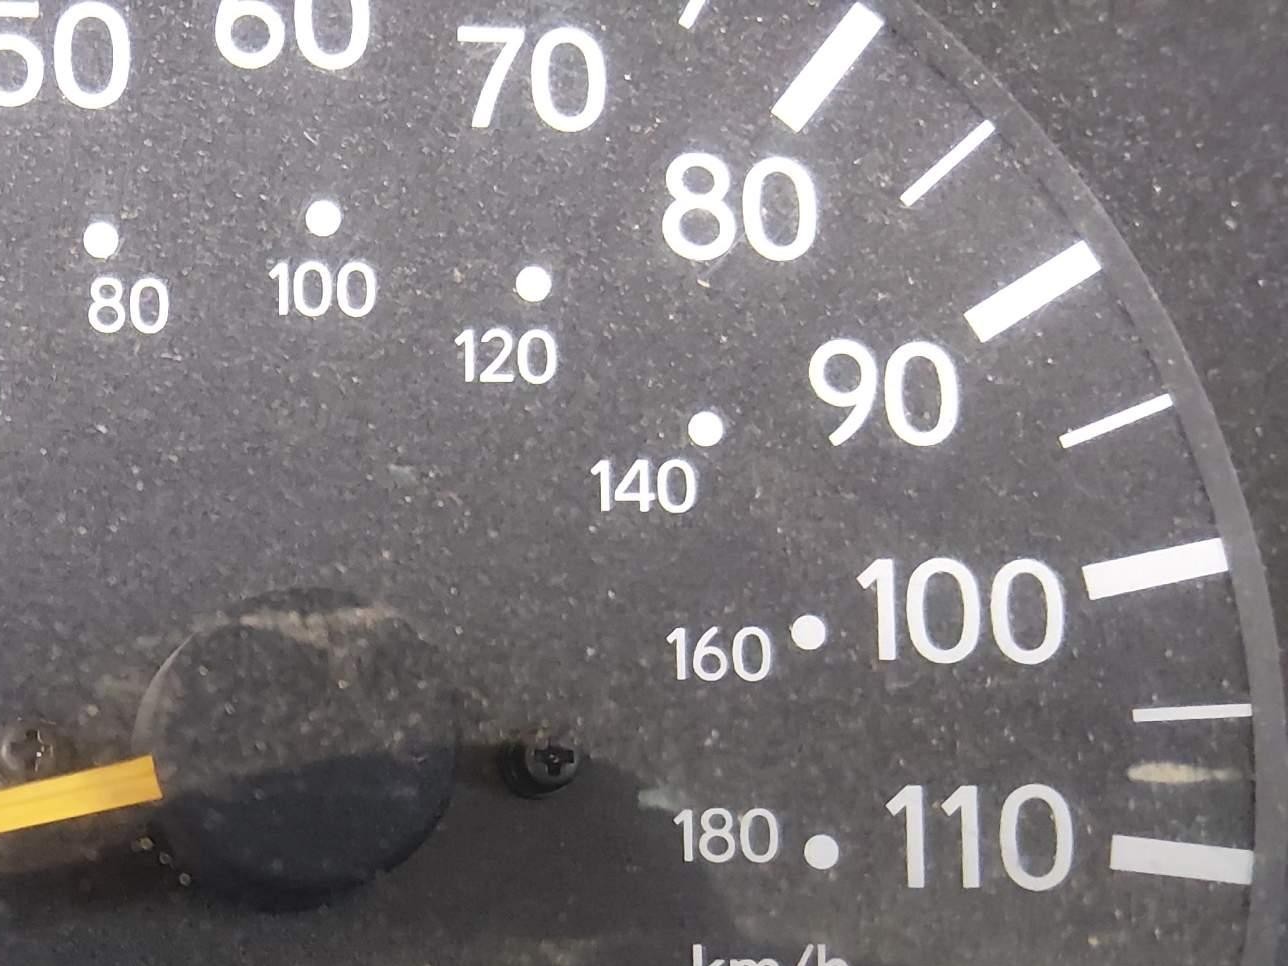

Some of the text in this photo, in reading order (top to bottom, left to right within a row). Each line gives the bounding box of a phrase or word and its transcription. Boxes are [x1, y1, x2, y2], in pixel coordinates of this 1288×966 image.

[215, 0, 370, 72] 60
[457, 24, 607, 132] 70
[662, 152, 819, 261] 80
[88, 276, 169, 333] 80
[269, 259, 378, 317] 100
[455, 327, 558, 384] 120
[809, 338, 959, 446] 90
[591, 457, 697, 513] 140
[857, 557, 1064, 664] 100
[667, 627, 771, 681] 160
[674, 808, 778, 862] 180
[886, 784, 1073, 891] 110
